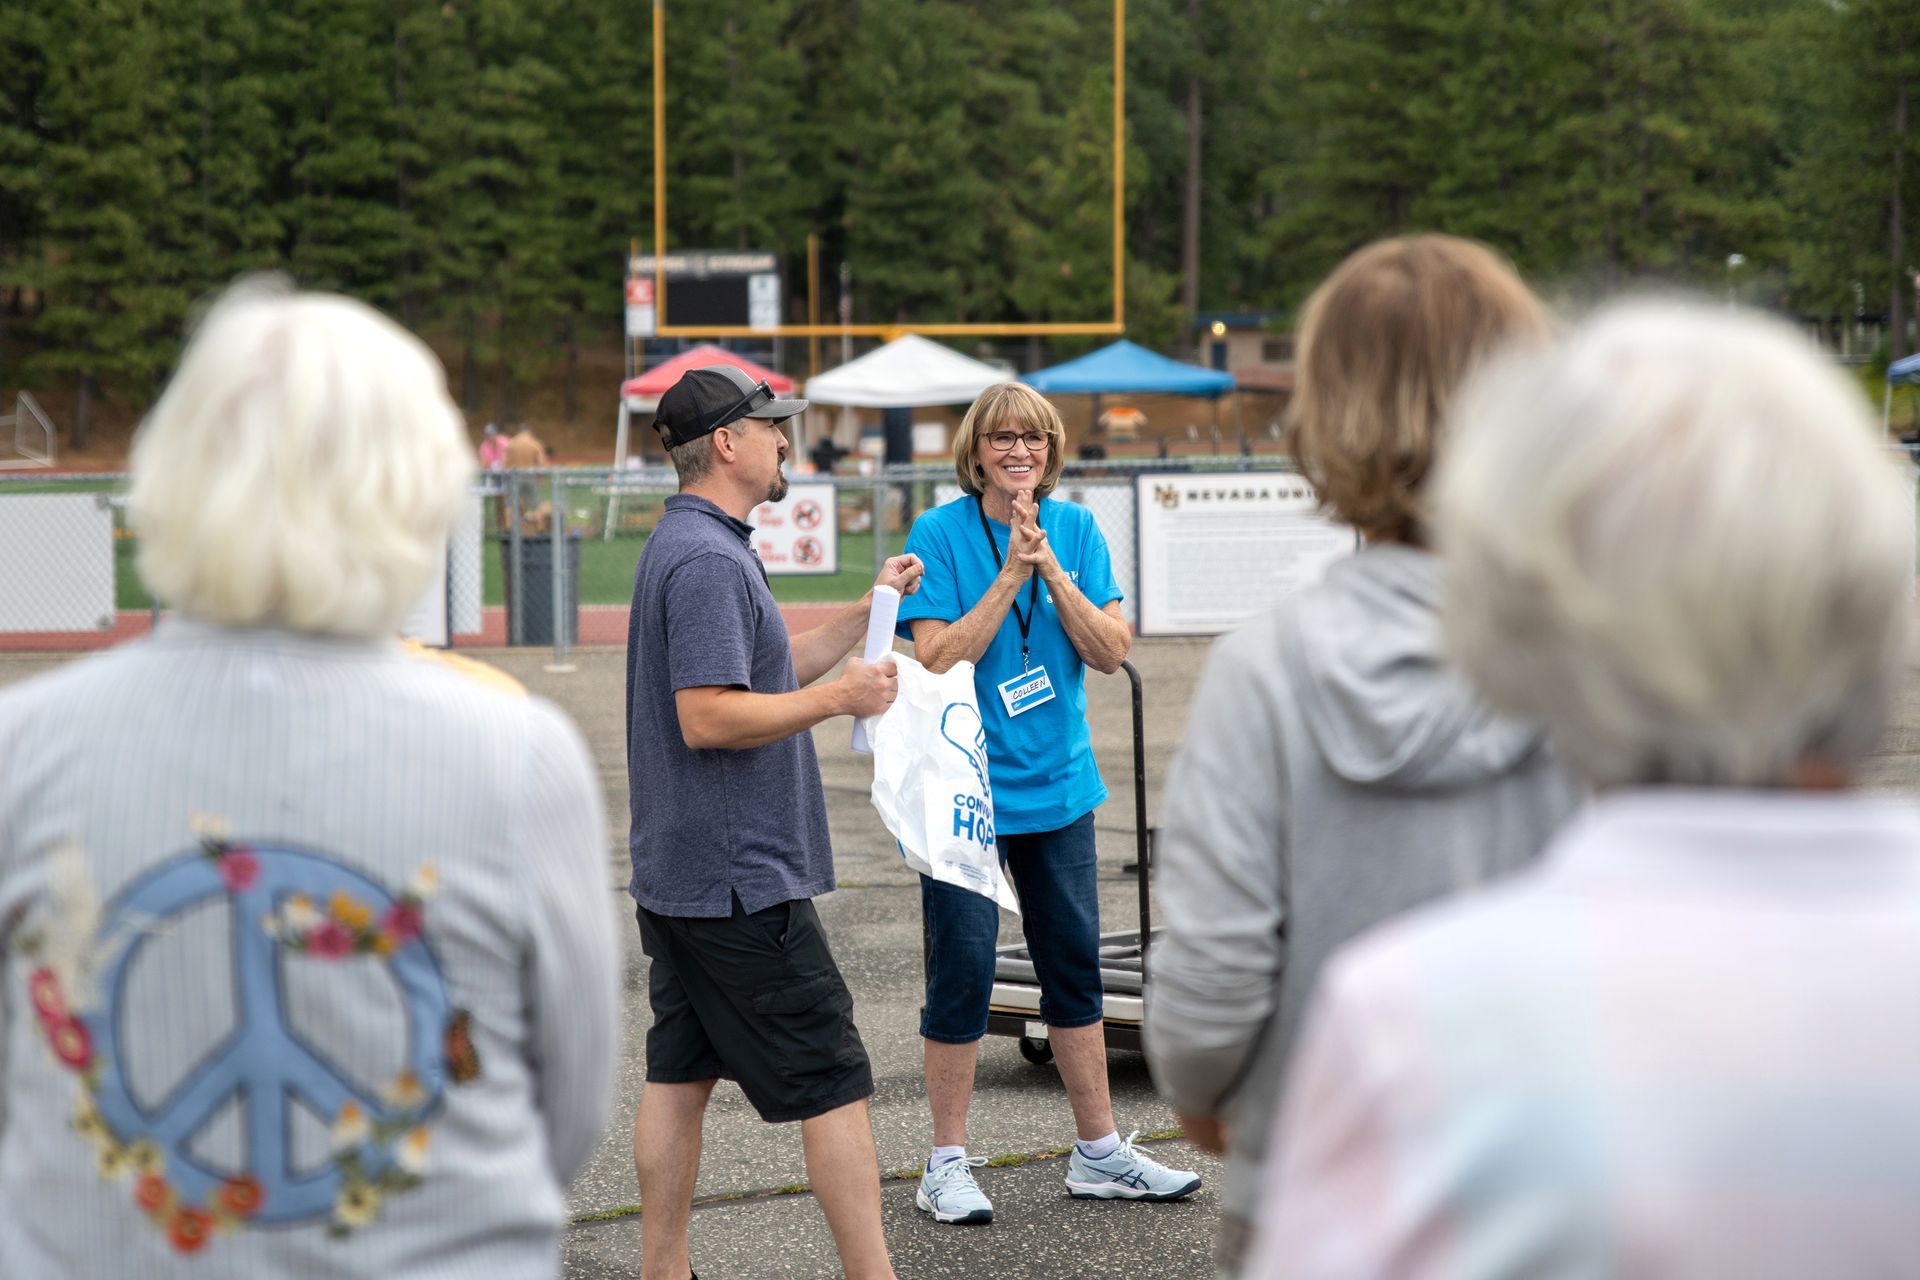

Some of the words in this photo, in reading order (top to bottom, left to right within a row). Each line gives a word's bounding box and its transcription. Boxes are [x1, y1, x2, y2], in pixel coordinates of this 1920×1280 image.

[1186, 488, 1270, 500] NEVADA
[1277, 487, 1318, 499] UNI
[1012, 677, 1046, 700] COLLEEN
